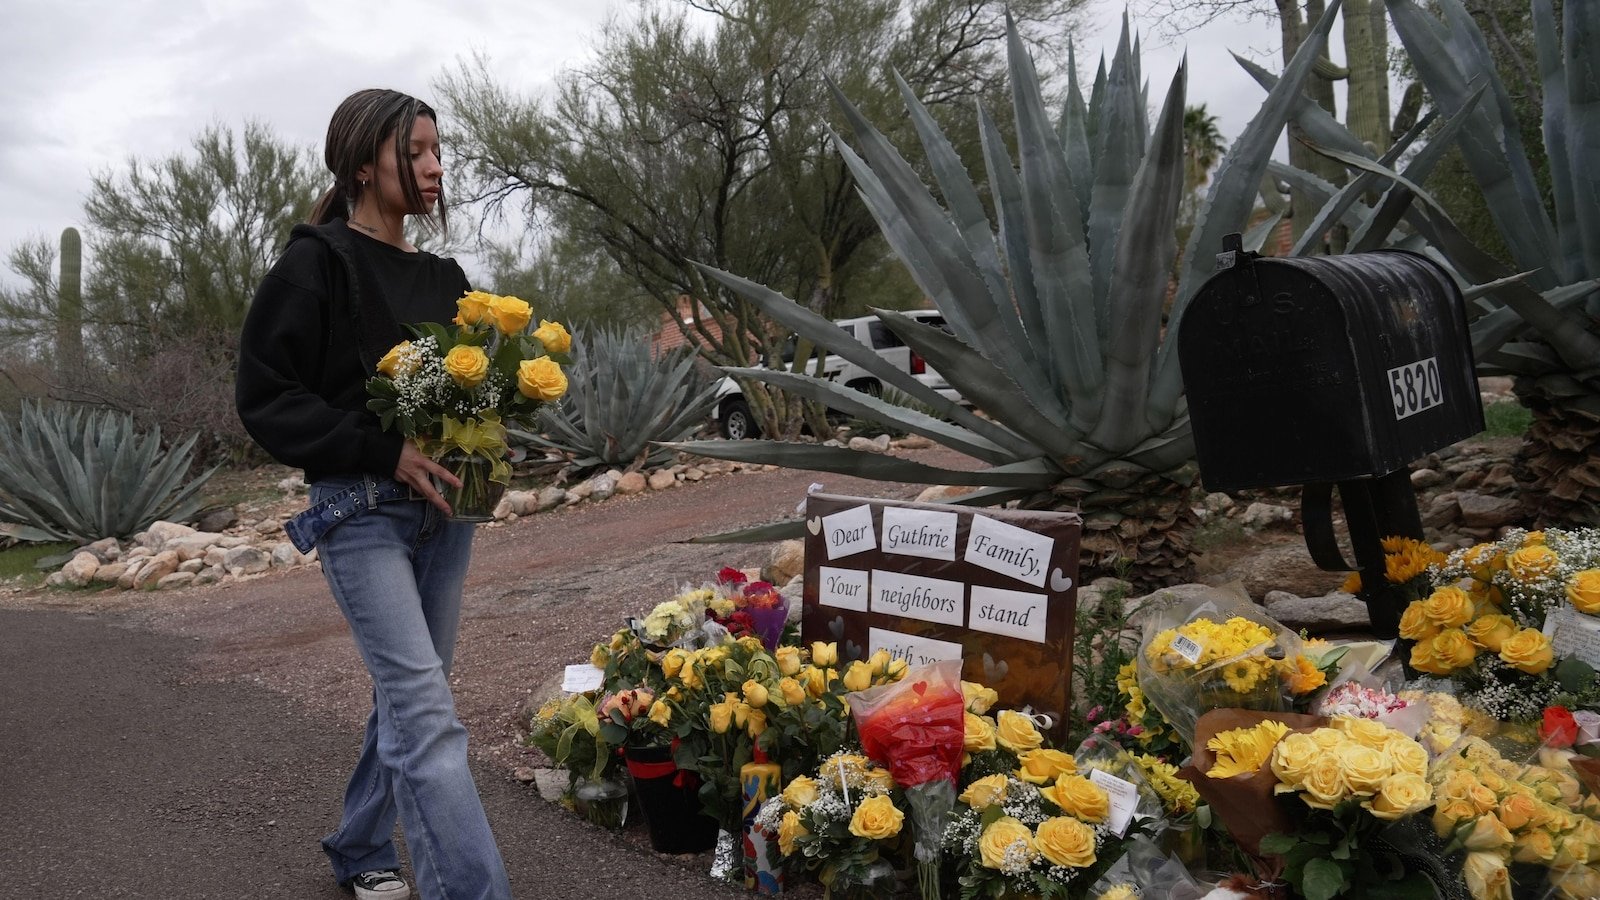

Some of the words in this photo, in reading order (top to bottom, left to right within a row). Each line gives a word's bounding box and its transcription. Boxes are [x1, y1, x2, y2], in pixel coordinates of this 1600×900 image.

[1391, 360, 1440, 416] 5820
[831, 525, 868, 547] Dear
[888, 524, 949, 549] Guthrie
[974, 534, 1040, 577] Family,
[826, 575, 862, 597] Your
[881, 586, 956, 613] neighbors
[978, 604, 1036, 627] stand
